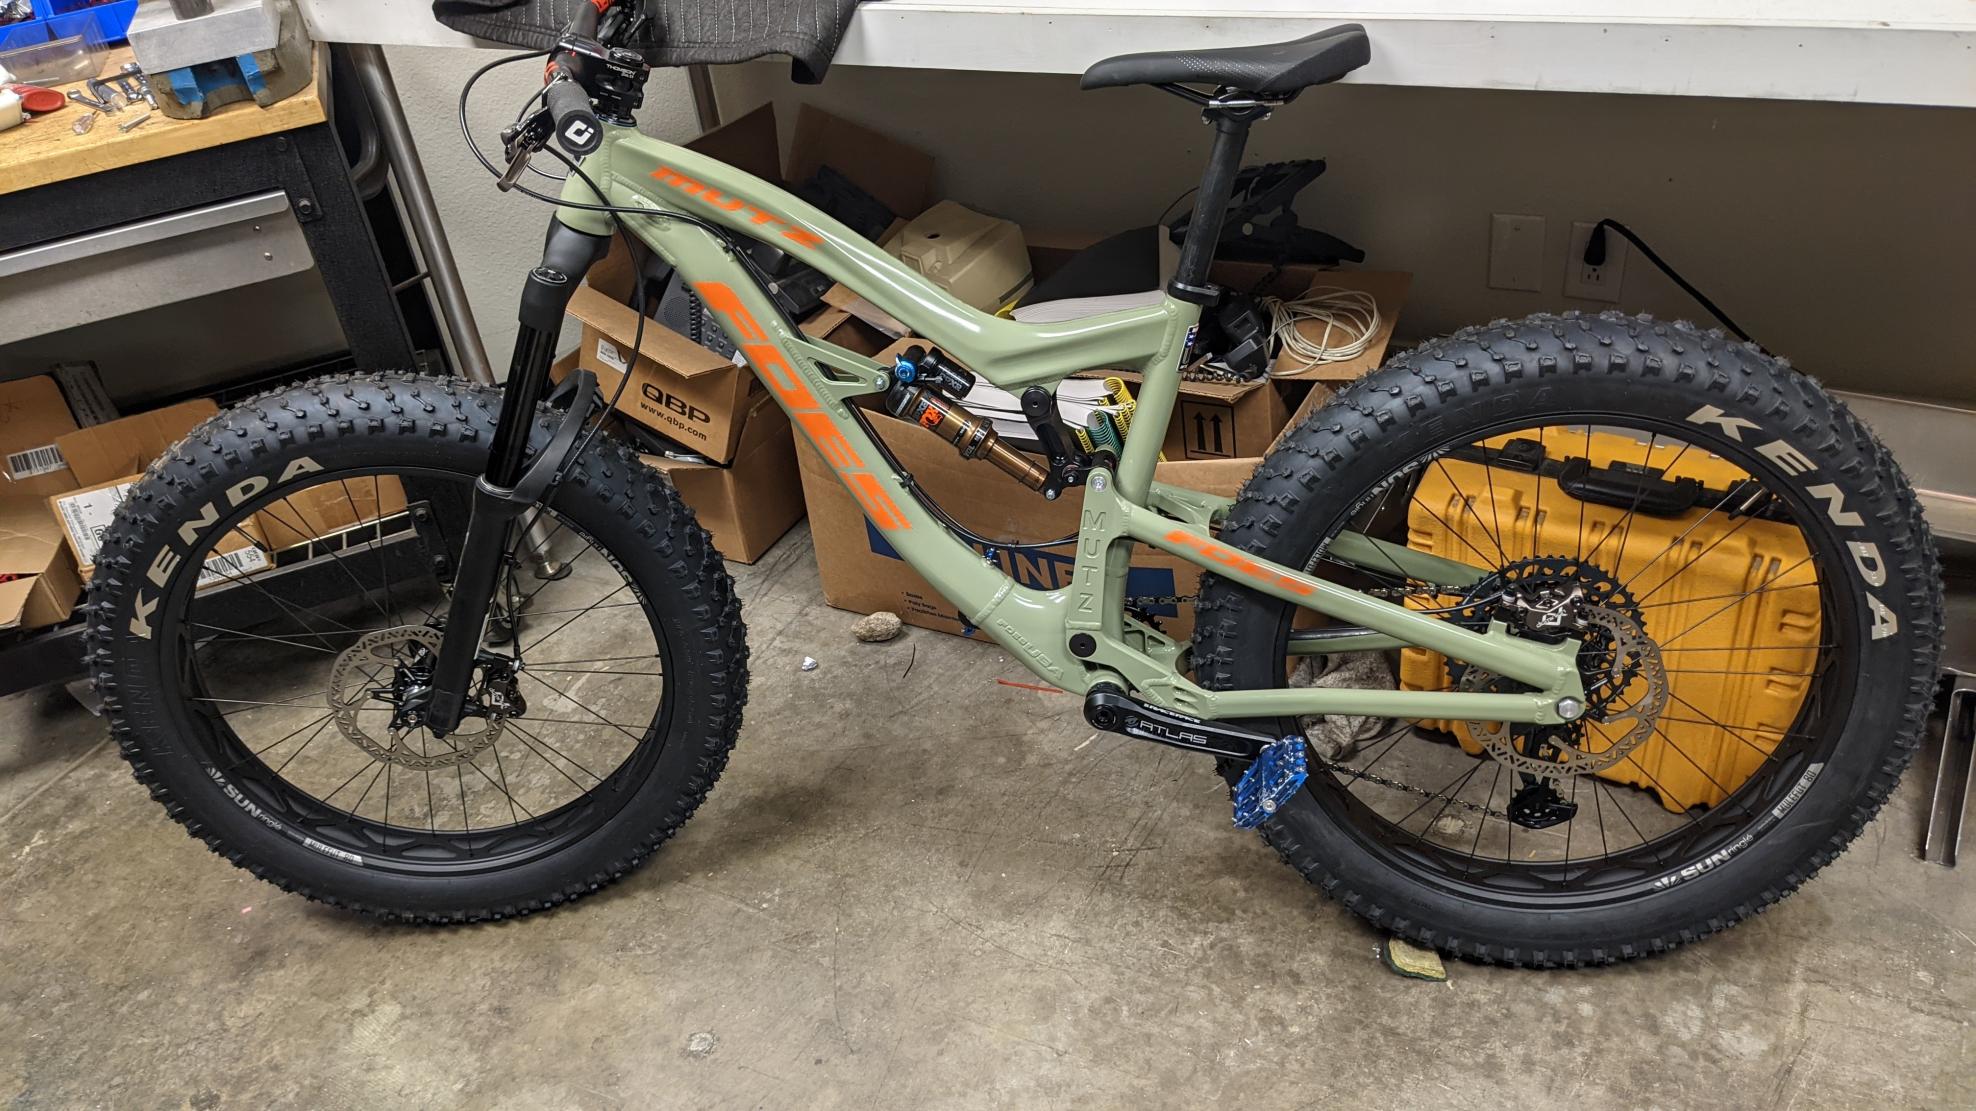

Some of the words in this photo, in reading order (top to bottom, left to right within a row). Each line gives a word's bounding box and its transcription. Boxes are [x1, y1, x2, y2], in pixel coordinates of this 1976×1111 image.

[640, 401, 707, 442] www.qbp.com
[641, 382, 711, 424] QBP
[1685, 404, 1899, 640] KENDA
[129, 456, 324, 640] KENDA
[1077, 508, 1106, 613] MUTZ
[1140, 720, 1208, 745] ATLAS
[222, 783, 262, 818] SUN
[1680, 849, 1731, 882] SUN
